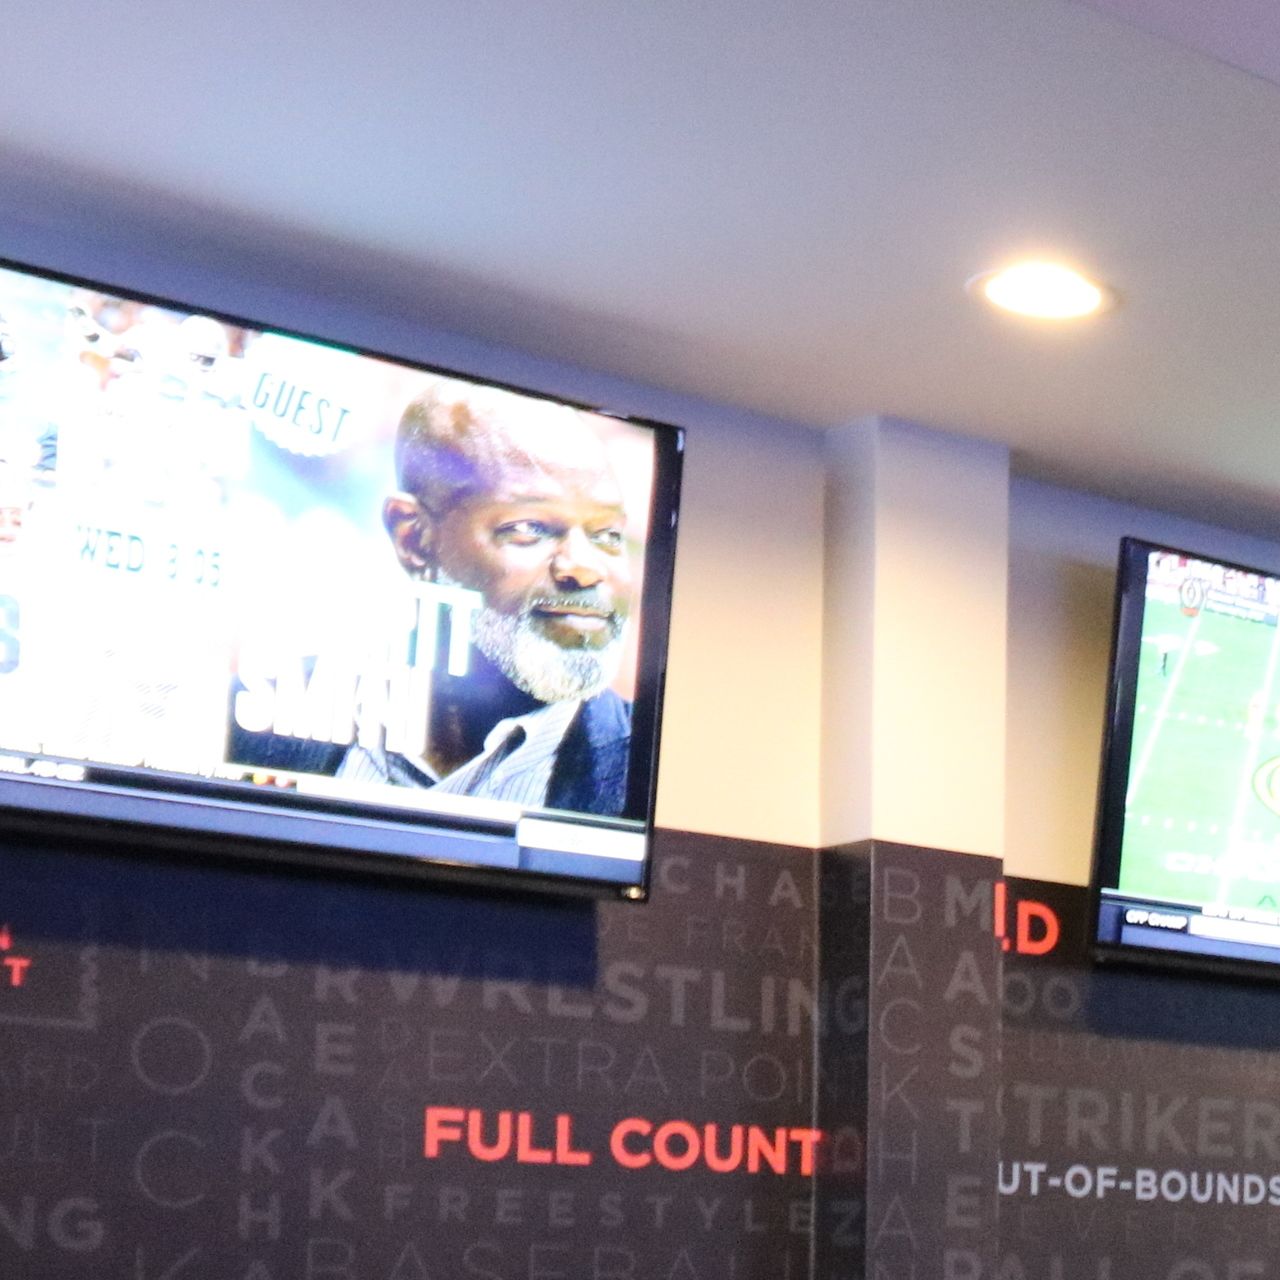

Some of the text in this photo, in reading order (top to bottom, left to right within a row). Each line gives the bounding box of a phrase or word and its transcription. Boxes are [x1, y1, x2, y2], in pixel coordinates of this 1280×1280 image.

[252, 371, 351, 444] GUEST
[76, 522, 146, 573] WED
[422, 1104, 823, 1178] FULL COUNT
